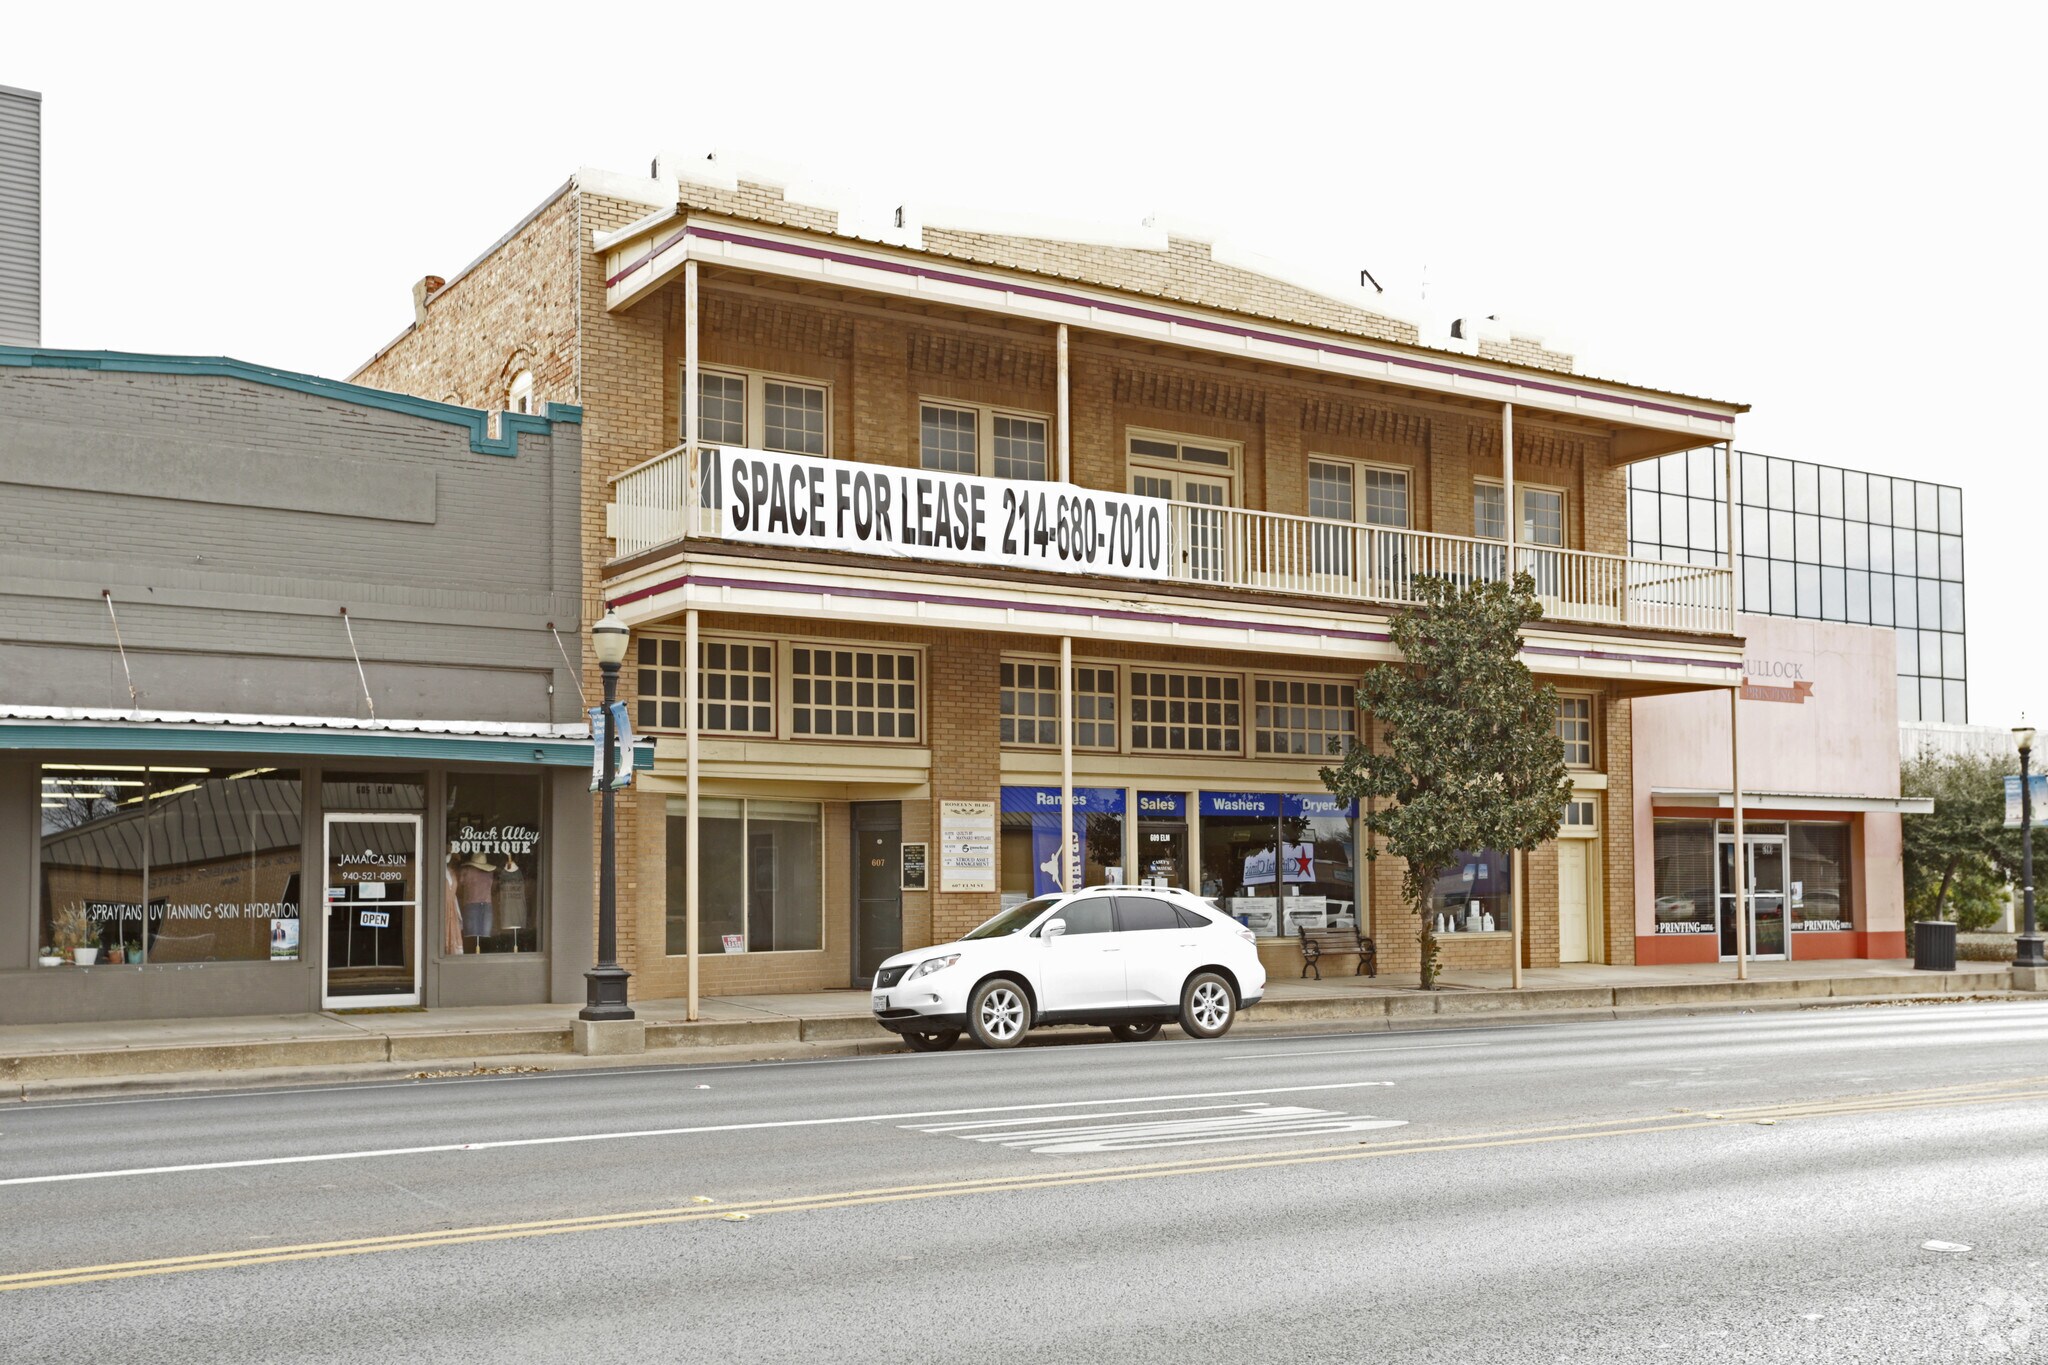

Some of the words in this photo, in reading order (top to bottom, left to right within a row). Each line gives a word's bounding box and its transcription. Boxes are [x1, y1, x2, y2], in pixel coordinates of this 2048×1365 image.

[731, 458, 826, 538] SPACE
[835, 468, 893, 542] FOR
[901, 476, 986, 552] LEASE
[1002, 487, 1161, 571] 214-680-7010
[1746, 687, 1797, 701] PRINTING
[377, 785, 393, 795] ELM
[1036, 792, 1087, 806] Ranes
[1140, 797, 1176, 811] Sales
[1213, 798, 1265, 811] Washers
[460, 825, 499, 840] Back
[501, 825, 541, 844] Alley
[450, 840, 531, 855] BOUTIQUE
[338, 852, 385, 867] JAMAICA
[388, 855, 407, 865] SUN
[872, 859, 885, 867] 607
[342, 871, 402, 881] 940-521-0890
[92, 903, 119, 920] SPRAY
[121, 903, 143, 919] TANS
[150, 904, 164, 920] UV
[166, 902, 212, 920] TANNING
[243, 902, 299, 919] HYDRATION
[362, 913, 388, 926] OPEN
[1804, 919, 1841, 931] PRINTING
[1659, 921, 1701, 933] PRINTING
